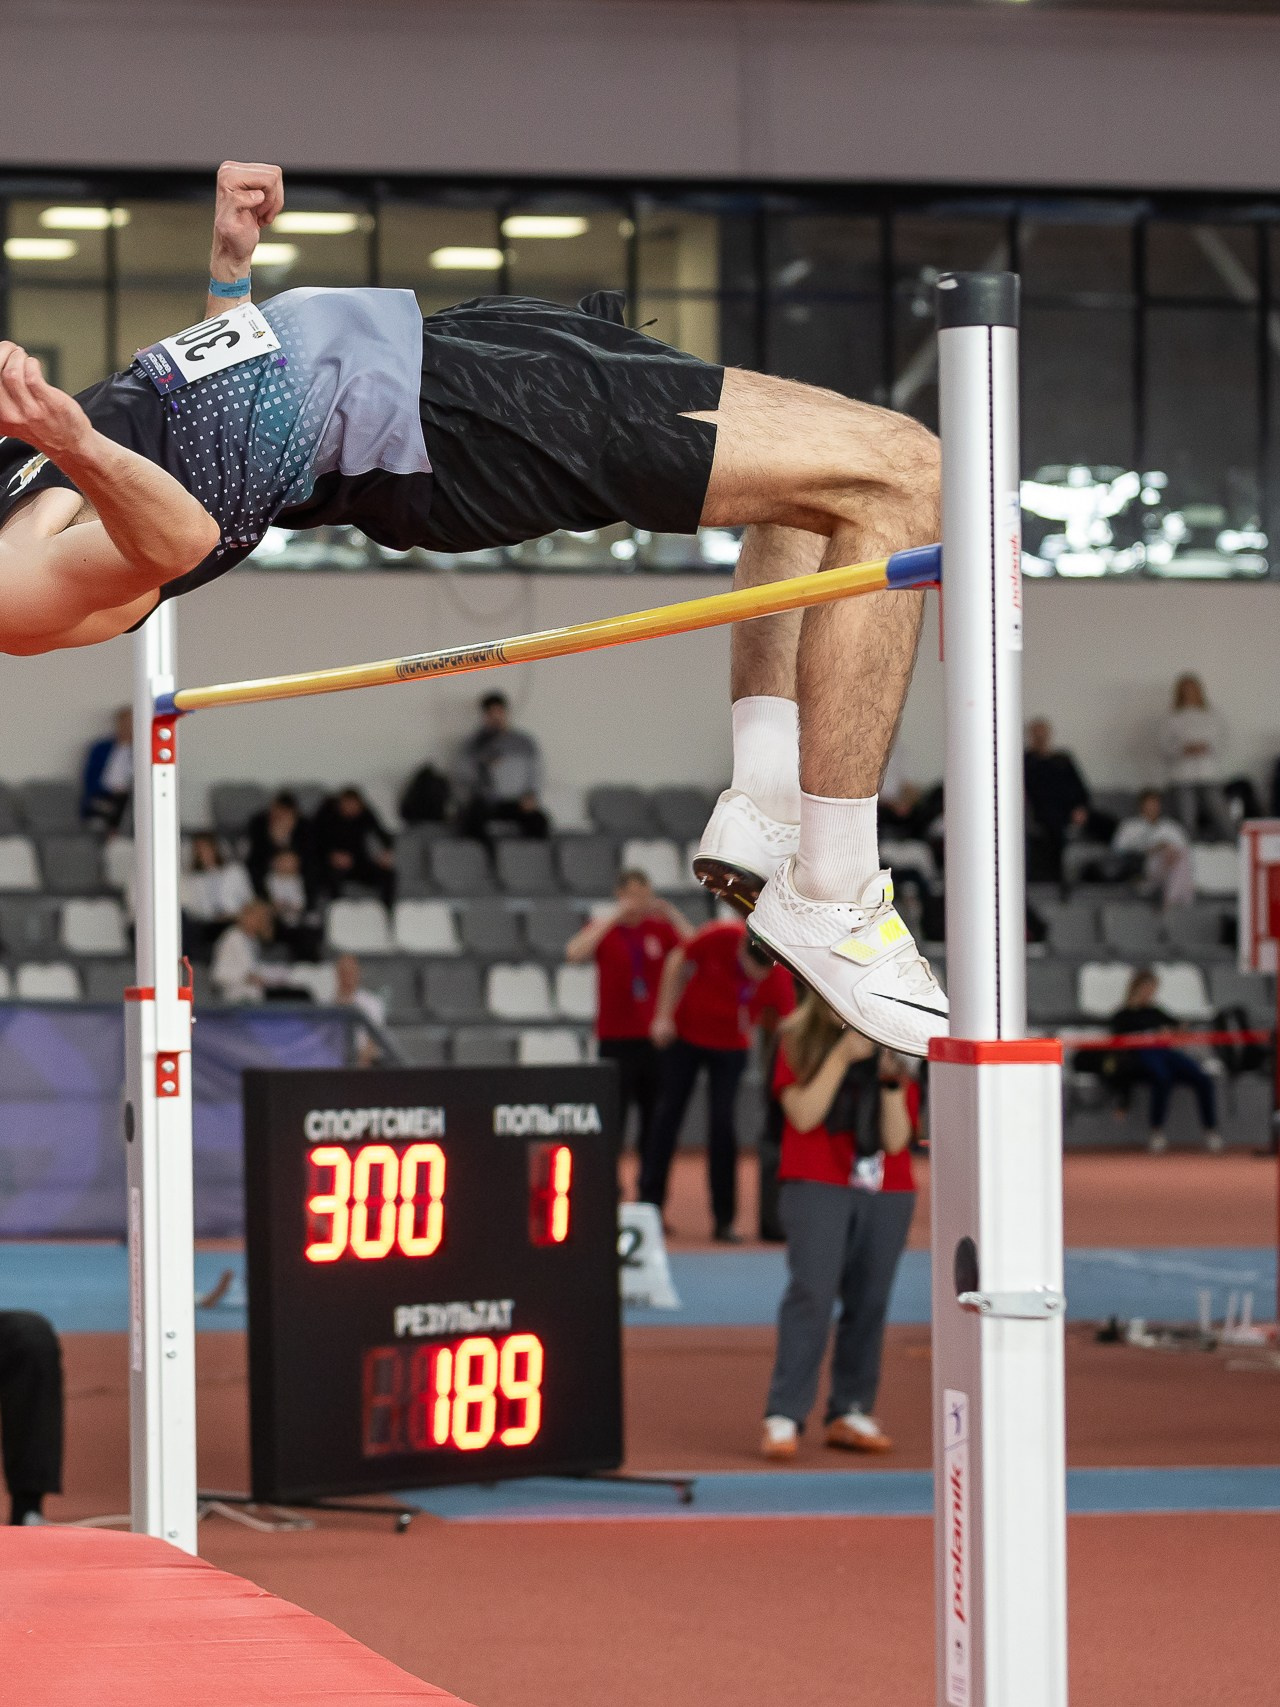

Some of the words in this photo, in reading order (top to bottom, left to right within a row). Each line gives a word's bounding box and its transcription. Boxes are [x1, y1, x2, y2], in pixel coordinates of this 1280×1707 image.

[168, 315, 241, 362] 30
[879, 918, 908, 947] NIK
[304, 1107, 446, 1141] СПОРТСМЕН
[493, 1104, 602, 1135] ПОПЫТКА
[304, 1143, 446, 1263] 300
[551, 1146, 573, 1243] 1
[617, 1225, 645, 1268] 2
[394, 1300, 516, 1337] РЕЗУЛЬТАТ
[432, 1332, 545, 1451] 189
[951, 1467, 966, 1623] polanik
